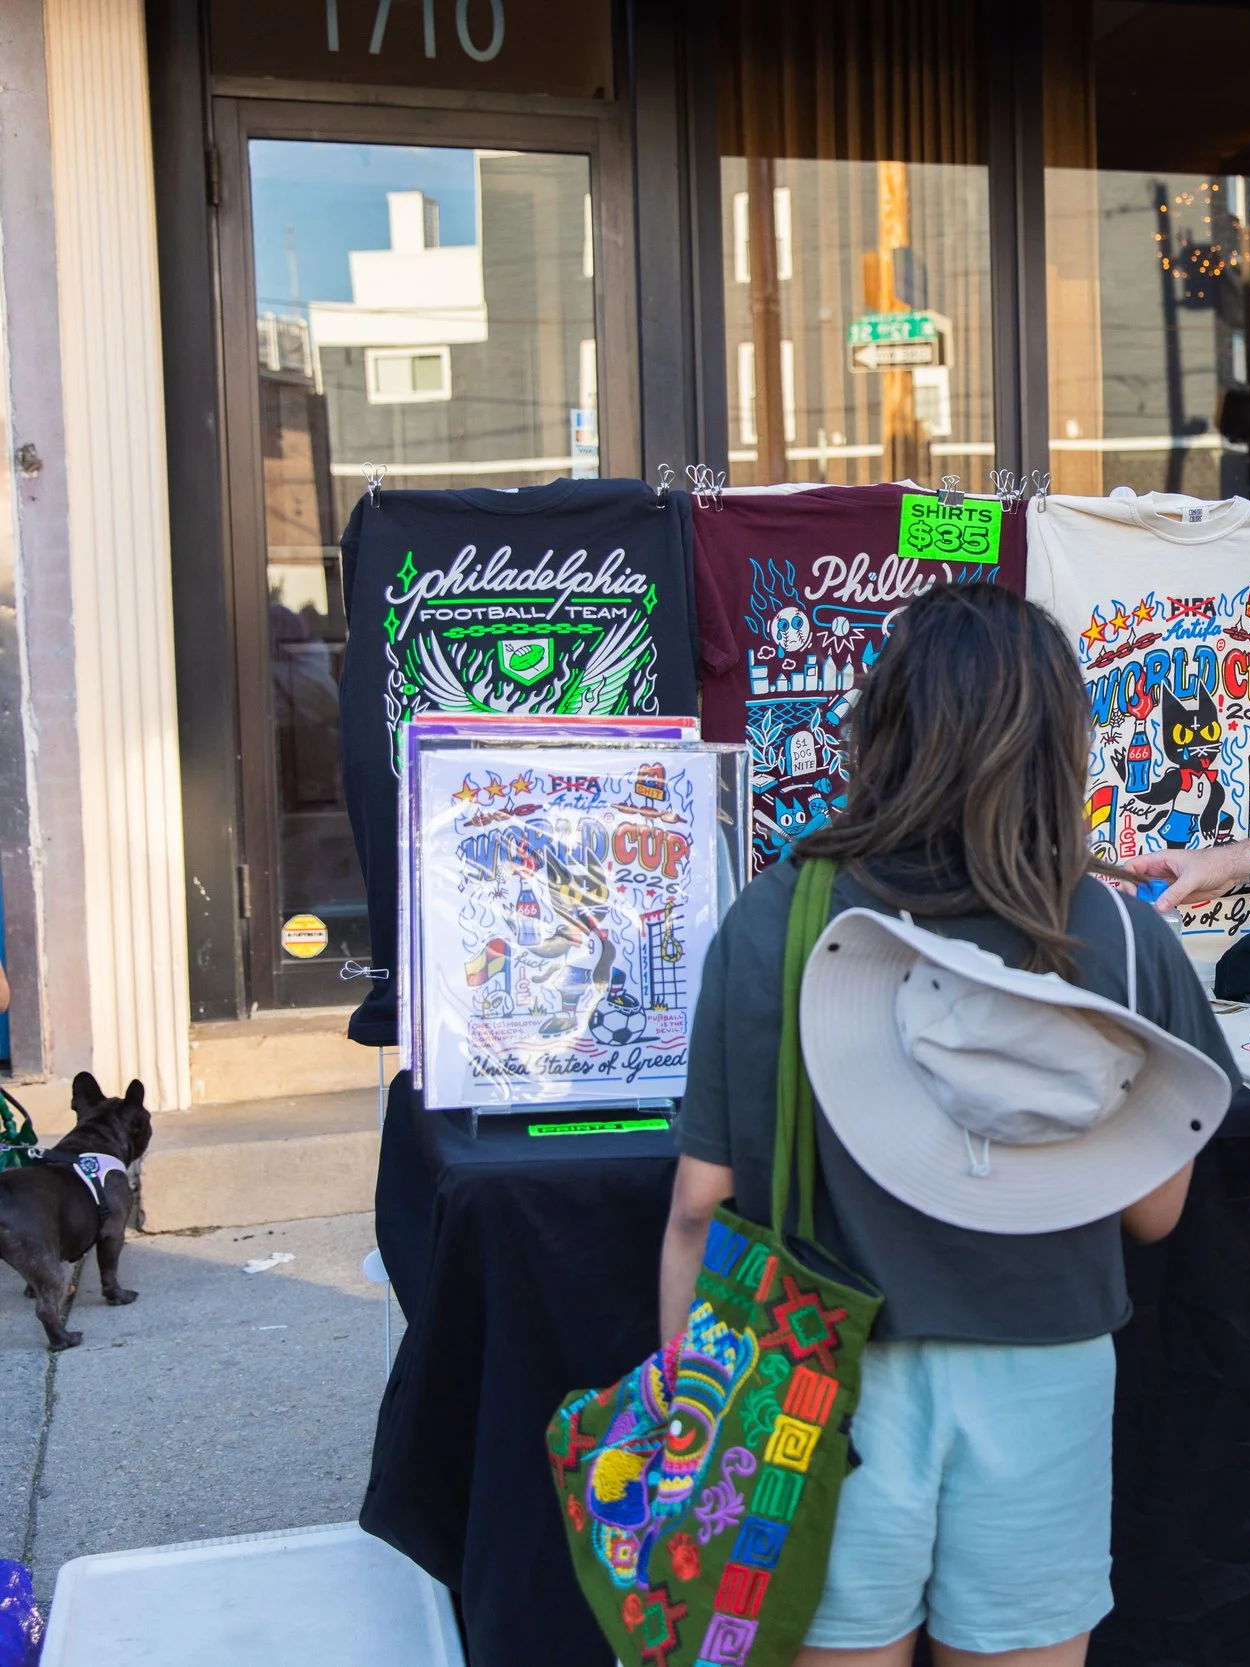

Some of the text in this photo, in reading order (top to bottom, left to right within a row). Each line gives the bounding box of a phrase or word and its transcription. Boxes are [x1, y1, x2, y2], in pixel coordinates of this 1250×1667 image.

[912, 504, 992, 523] SHIRTS
[907, 520, 990, 555] $35
[420, 606, 628, 622] FOOTBALL TEAM
[1170, 597, 1217, 618] FIFA
[1162, 616, 1223, 642] Antifa
[1087, 645, 1219, 727] WORLD
[793, 749, 812, 760] DOG
[1128, 749, 1149, 759] 666
[794, 760, 815, 771] NITE
[551, 776, 601, 793] FIFA
[636, 785, 663, 799] SHIT
[548, 793, 608, 814] Antifa
[1120, 814, 1137, 858] ICE
[611, 821, 691, 879] CUP
[615, 868, 680, 894] 2026
[518, 906, 538, 914] 666
[1200, 901, 1223, 927] of
[515, 967, 531, 1007] ICE
[469, 1047, 687, 1083] United States of Greed
